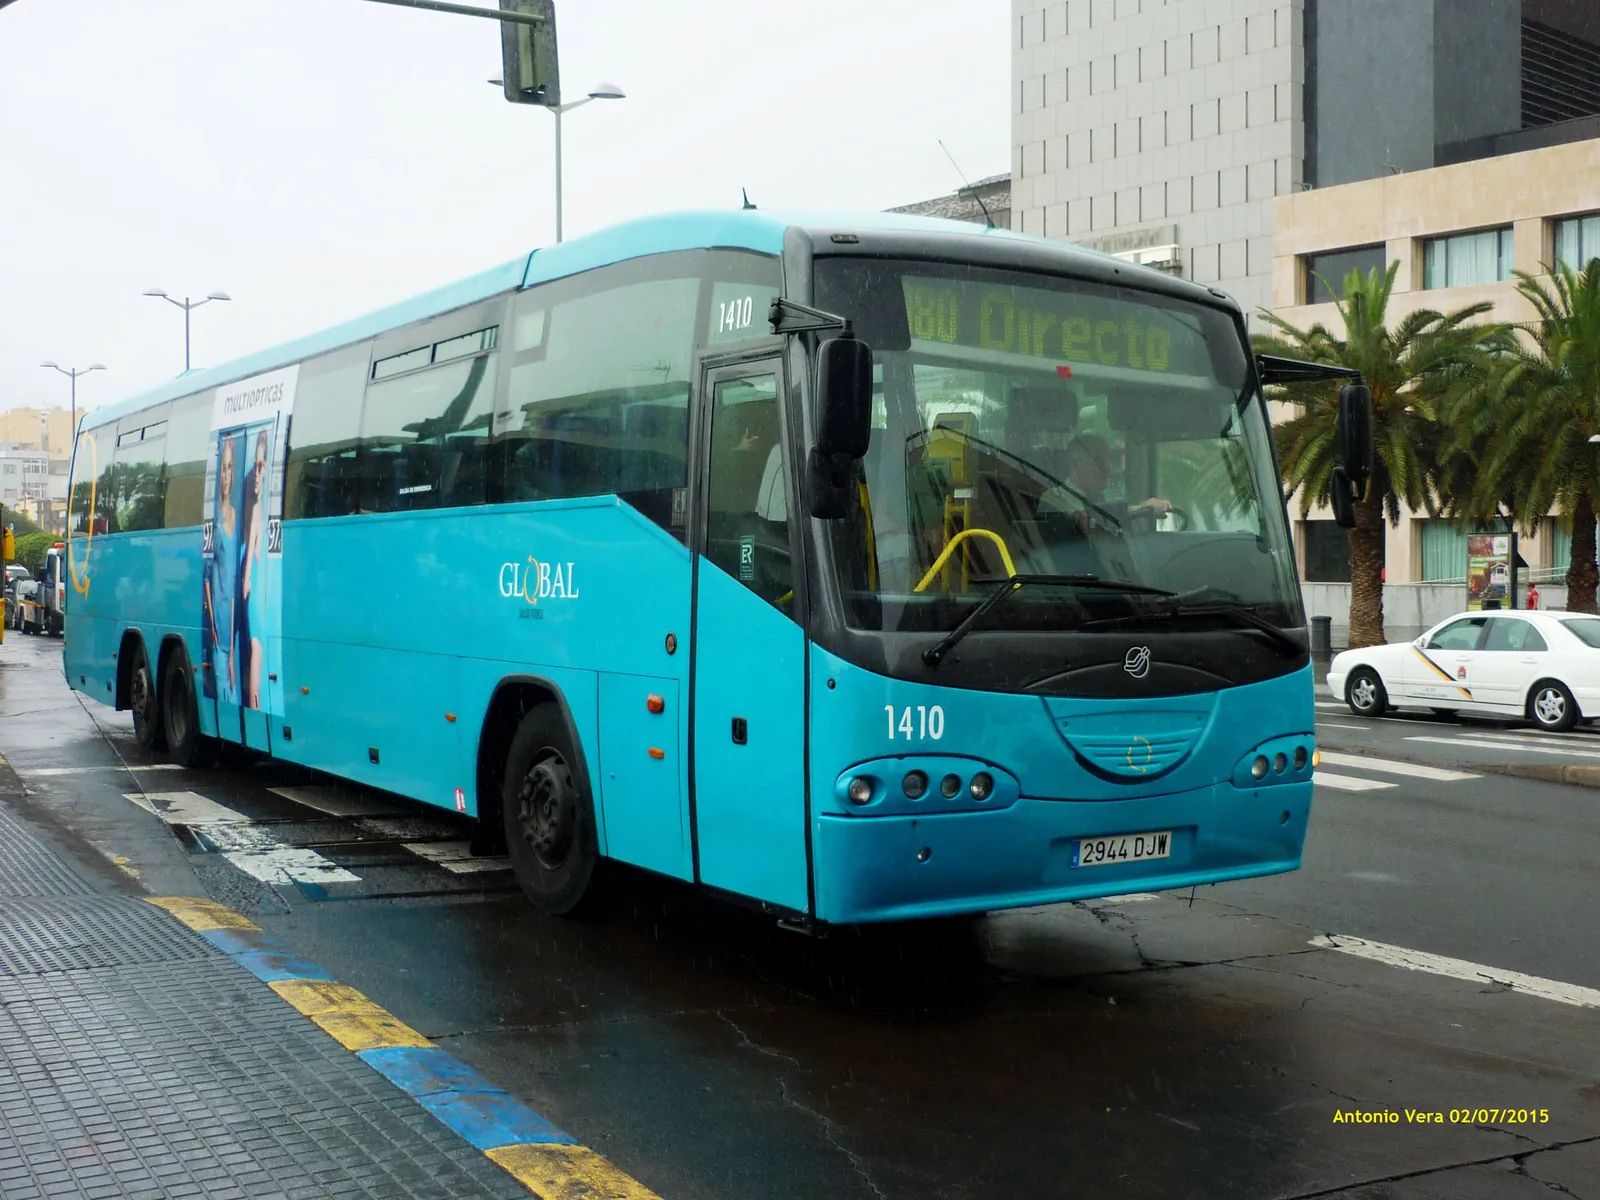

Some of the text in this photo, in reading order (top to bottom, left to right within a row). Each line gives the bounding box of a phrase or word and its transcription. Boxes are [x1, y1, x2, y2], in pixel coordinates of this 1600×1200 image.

[720, 296, 753, 333] 1410
[980, 291, 1170, 371] Directo
[499, 555, 580, 605] GLOBAL
[884, 704, 945, 741] 1410
[1083, 834, 1168, 864] 2944 DJW
